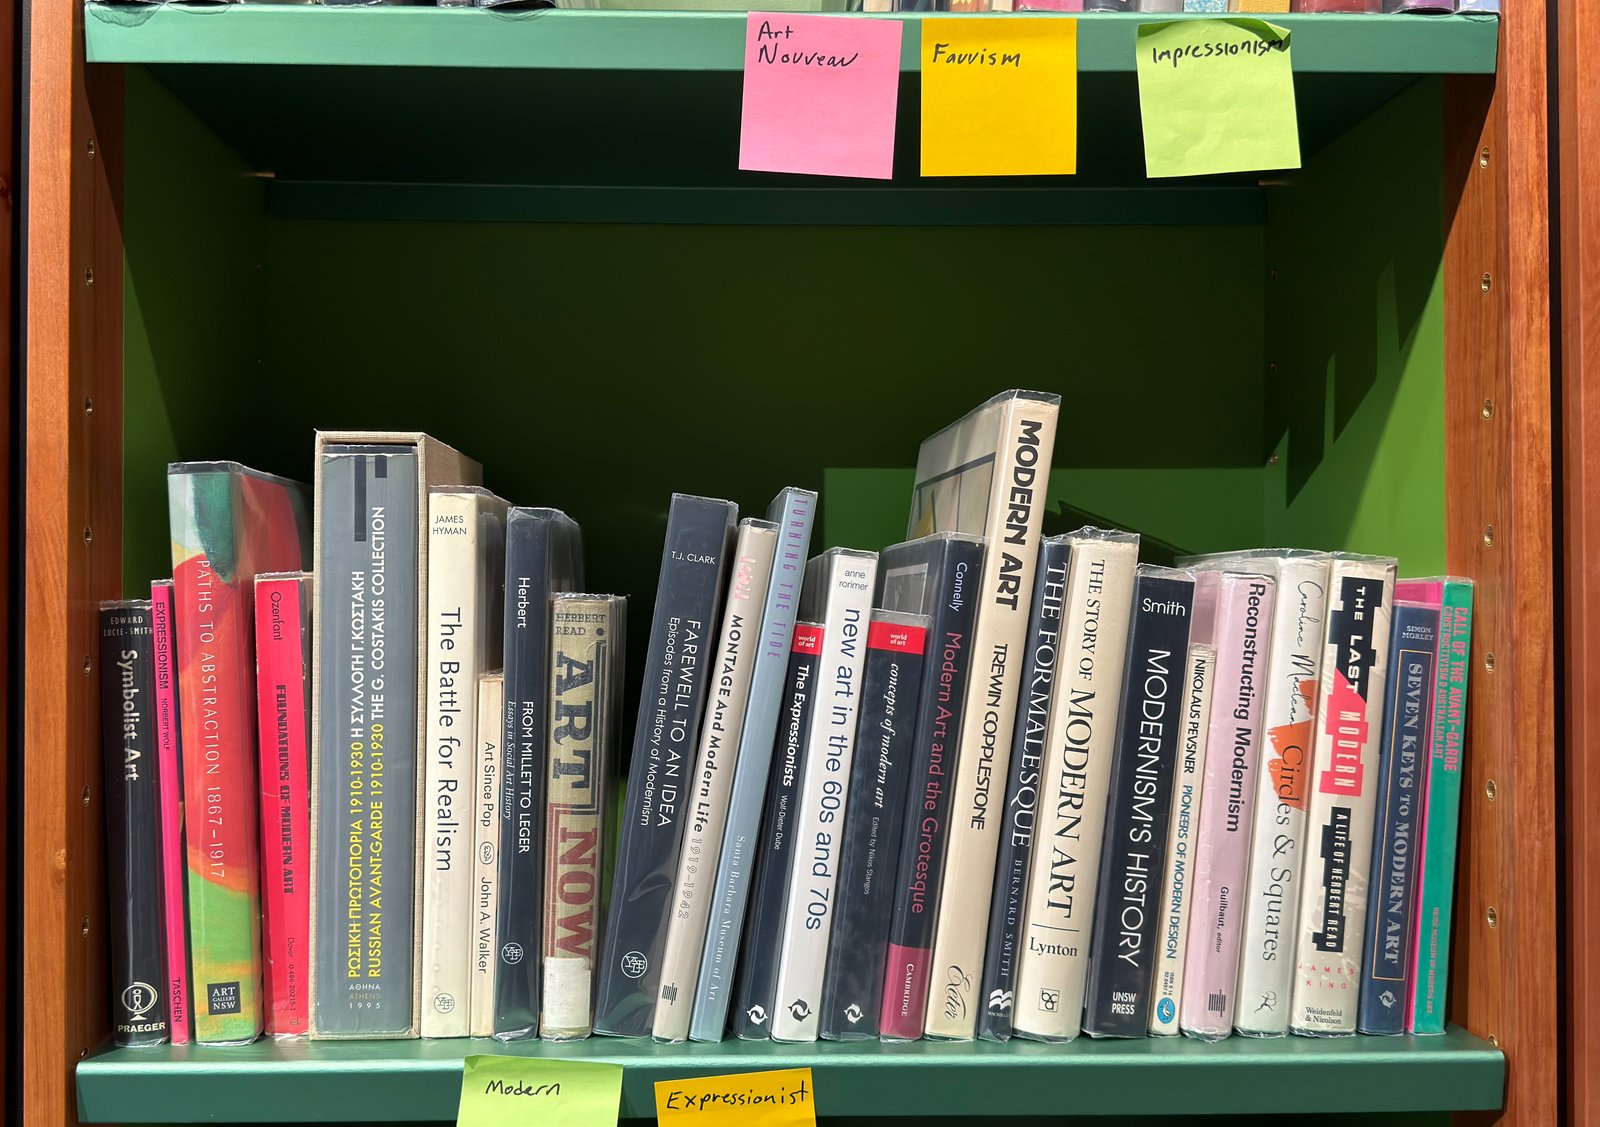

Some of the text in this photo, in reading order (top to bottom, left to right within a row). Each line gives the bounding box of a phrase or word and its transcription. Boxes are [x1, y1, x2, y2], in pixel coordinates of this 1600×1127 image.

[758, 21, 794, 42] Art
[932, 43, 1021, 67] Fauvism
[1152, 38, 1285, 65] Impressionism
[433, 527, 467, 535] HYMAN
[435, 516, 464, 524] JAMES
[687, 554, 715, 565] CLARK
[197, 560, 212, 612] PATHS
[271, 592, 285, 641] Ozenfant
[518, 578, 530, 628] Herbert
[767, 499, 808, 658] TURNING THE TIDE
[839, 580, 869, 591] rorimer
[844, 570, 865, 579] anne
[1143, 598, 1185, 617] Smith
[110, 616, 144, 625] EDWARD
[156, 602, 168, 689] EXPRESSIONISM
[200, 622, 214, 643] TO
[556, 613, 605, 623] HERBERT
[556, 627, 586, 636] READ
[971, 420, 1042, 830] MODERN ART TREWIN COPPLESTONE
[1287, 580, 1323, 728] Caroline Maclean
[1402, 632, 1434, 641] MORLEY
[1406, 625, 1431, 633] SIMON
[117, 650, 141, 781] Symbolist Art
[201, 652, 220, 774] ABSTRACTION
[553, 652, 593, 788] ART
[641, 616, 680, 826] Episodes from History Modernism
[657, 619, 701, 826] FAREWELL TO AN IDEA
[783, 664, 809, 786] The Expressionists
[876, 663, 899, 784] concepts modern
[1226, 583, 1266, 832] Reconstructing Modernism
[1334, 587, 1366, 788] THE LAST MODERN
[1444, 607, 1468, 772] CALL OF THE AVANT-GARDE
[351, 742, 364, 817] 1910-1930
[368, 506, 385, 978] RUSSIAN AVANT-GARDE 1910-1930 THE COSTAKIS COLLECTION
[436, 607, 462, 871] The Battle for Realism
[503, 701, 516, 820] Essays Social History
[518, 702, 533, 853] FROM MILLET TO LEGER
[678, 615, 743, 919] MONTAGE And Modern Life 1919-1942
[805, 608, 860, 930] new art in the 60s and 70s
[909, 562, 967, 913] Connelly Modern Art and the Grotesque
[1000, 562, 1066, 977] THE FORMALESQUE BERNARD SMITH
[1047, 559, 1105, 918] THE STORY OF MODERN ART
[276, 685, 294, 895] FOUNDATIONS MODERN ART
[482, 742, 496, 827] Art Since Pop
[1118, 649, 1171, 967] MODERNISM'S HISTORY
[1167, 659, 1206, 959] NIKOLAUS PEVSNER PIONEERS MODERN DESIGN
[1384, 663, 1422, 964] SEVEN KEYS MODERN ART
[557, 827, 598, 958] NOW
[1263, 745, 1303, 961] Circles & Squares
[1326, 823, 1347, 948] LIFE HERBERT READ
[479, 877, 492, 973] John Walker
[717, 836, 746, 963] Santa Barbara Museum
[1029, 936, 1078, 957] Lynton
[118, 1022, 165, 1033] PRAEGER
[173, 978, 182, 1022] TASCHEN
[212, 986, 236, 996] ART
[213, 1002, 236, 1010] NSW
[902, 963, 914, 1016] CAMBRIDGE
[944, 965, 971, 1021] Exeter
[1112, 1004, 1135, 1015] PRESS
[1113, 992, 1136, 1002] UNSW
[1306, 1006, 1342, 1017] Weidenfeld
[1312, 1016, 1341, 1024] Nicolson
[486, 1080, 560, 1097] Modern
[666, 1080, 809, 1111] Expressionist
